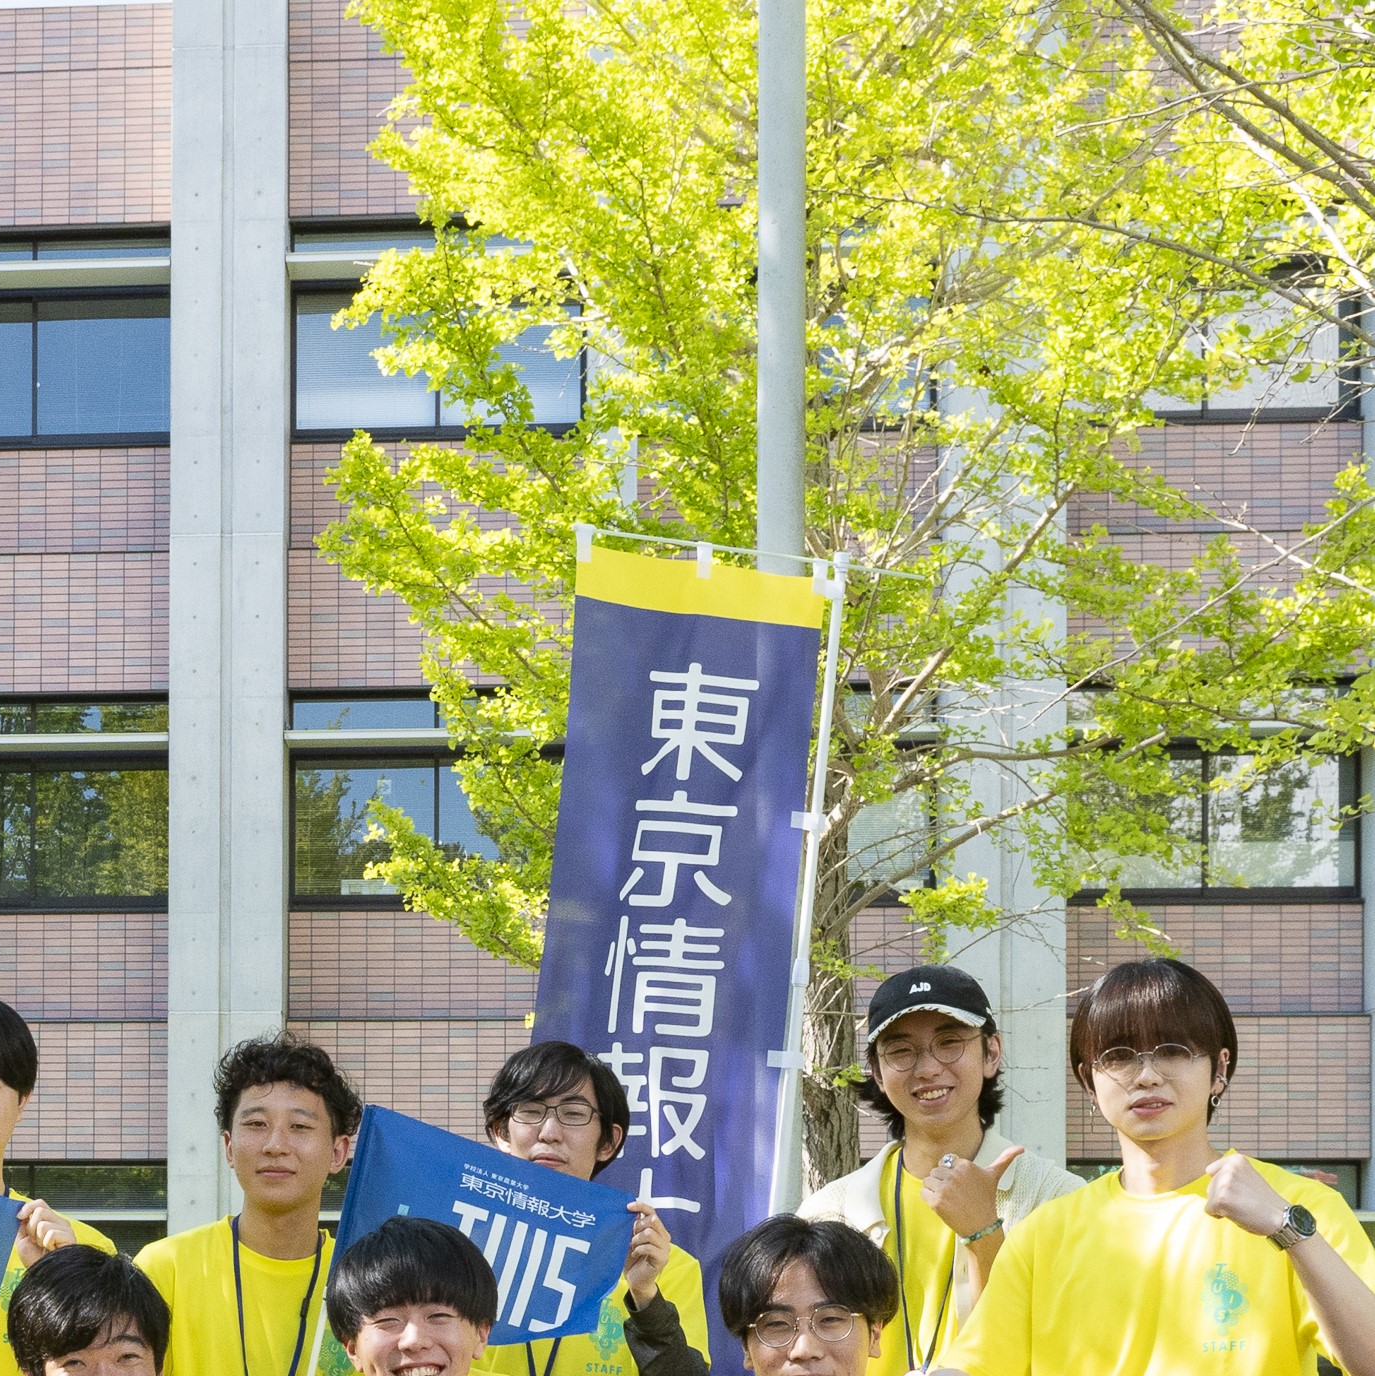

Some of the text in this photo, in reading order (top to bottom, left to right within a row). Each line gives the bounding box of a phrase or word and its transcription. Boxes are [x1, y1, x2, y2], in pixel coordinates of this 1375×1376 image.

[460, 1172, 596, 1228] 東京情報大学
[1203, 1340, 1246, 1353] STAFF
[585, 1362, 623, 1376] STAFF
